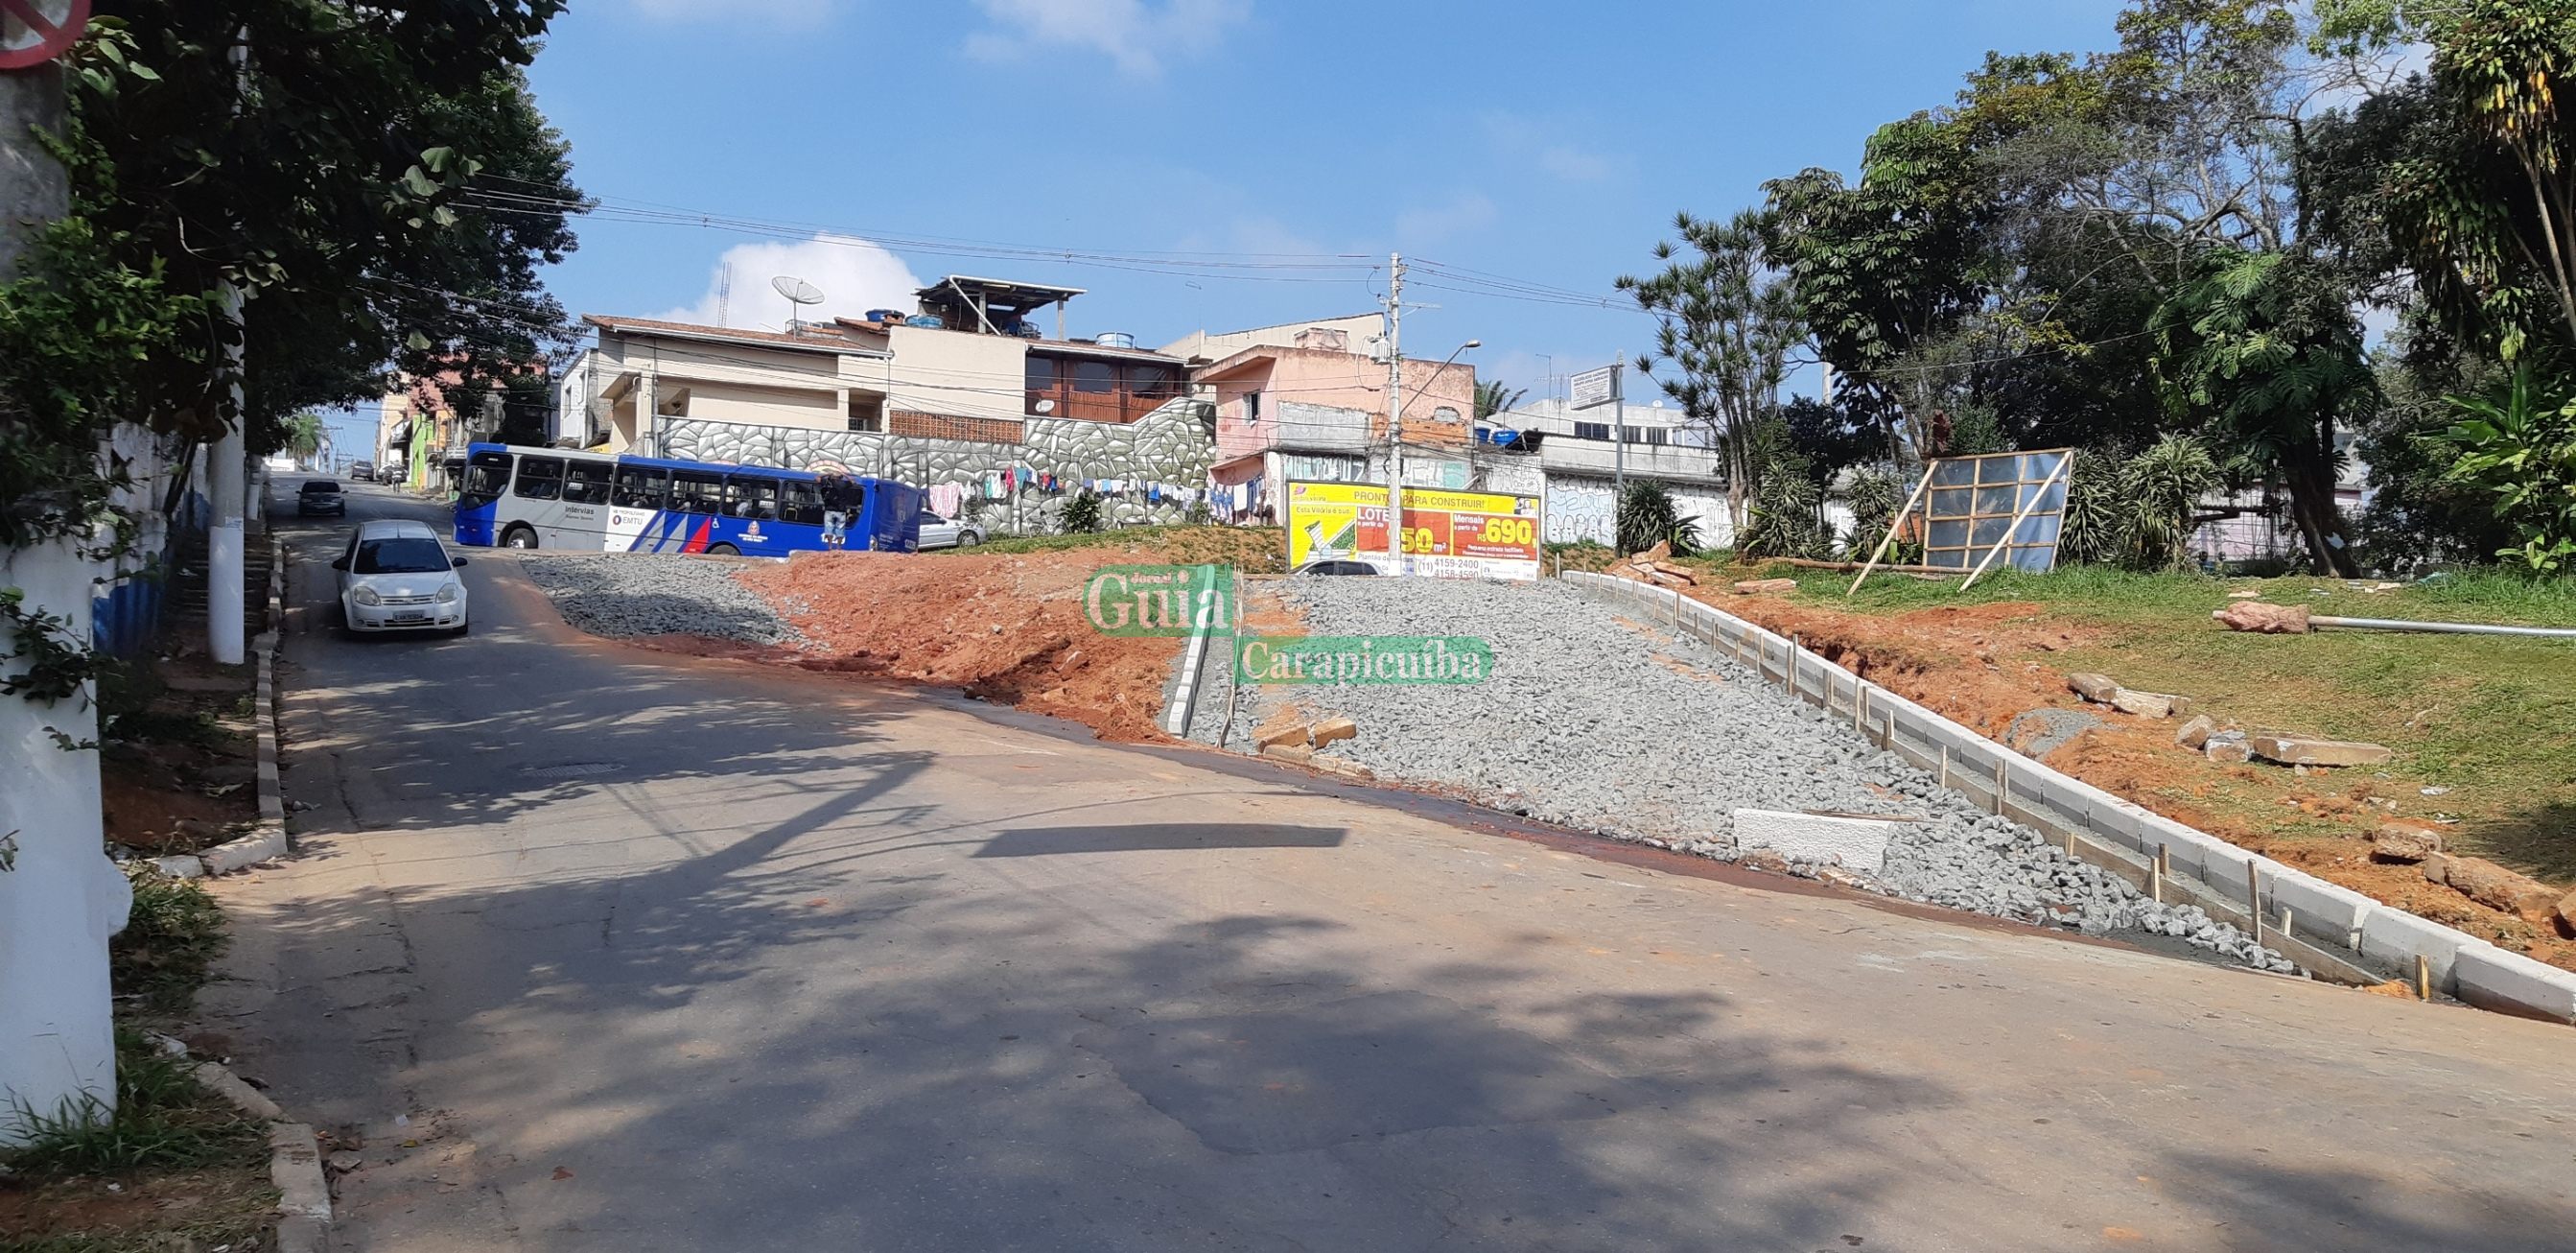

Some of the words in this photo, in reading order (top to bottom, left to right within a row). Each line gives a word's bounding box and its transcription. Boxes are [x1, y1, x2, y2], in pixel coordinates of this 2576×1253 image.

[1402, 495, 1427, 506] PARA
[1431, 497, 1485, 508] CONSTRUIR!
[565, 506, 595, 515] Intervias
[622, 517, 644, 526] EMTU
[1454, 514, 1485, 525] Mensais
[1418, 561, 1433, 573] (11)
[1435, 557, 1479, 568] 4159-2400
